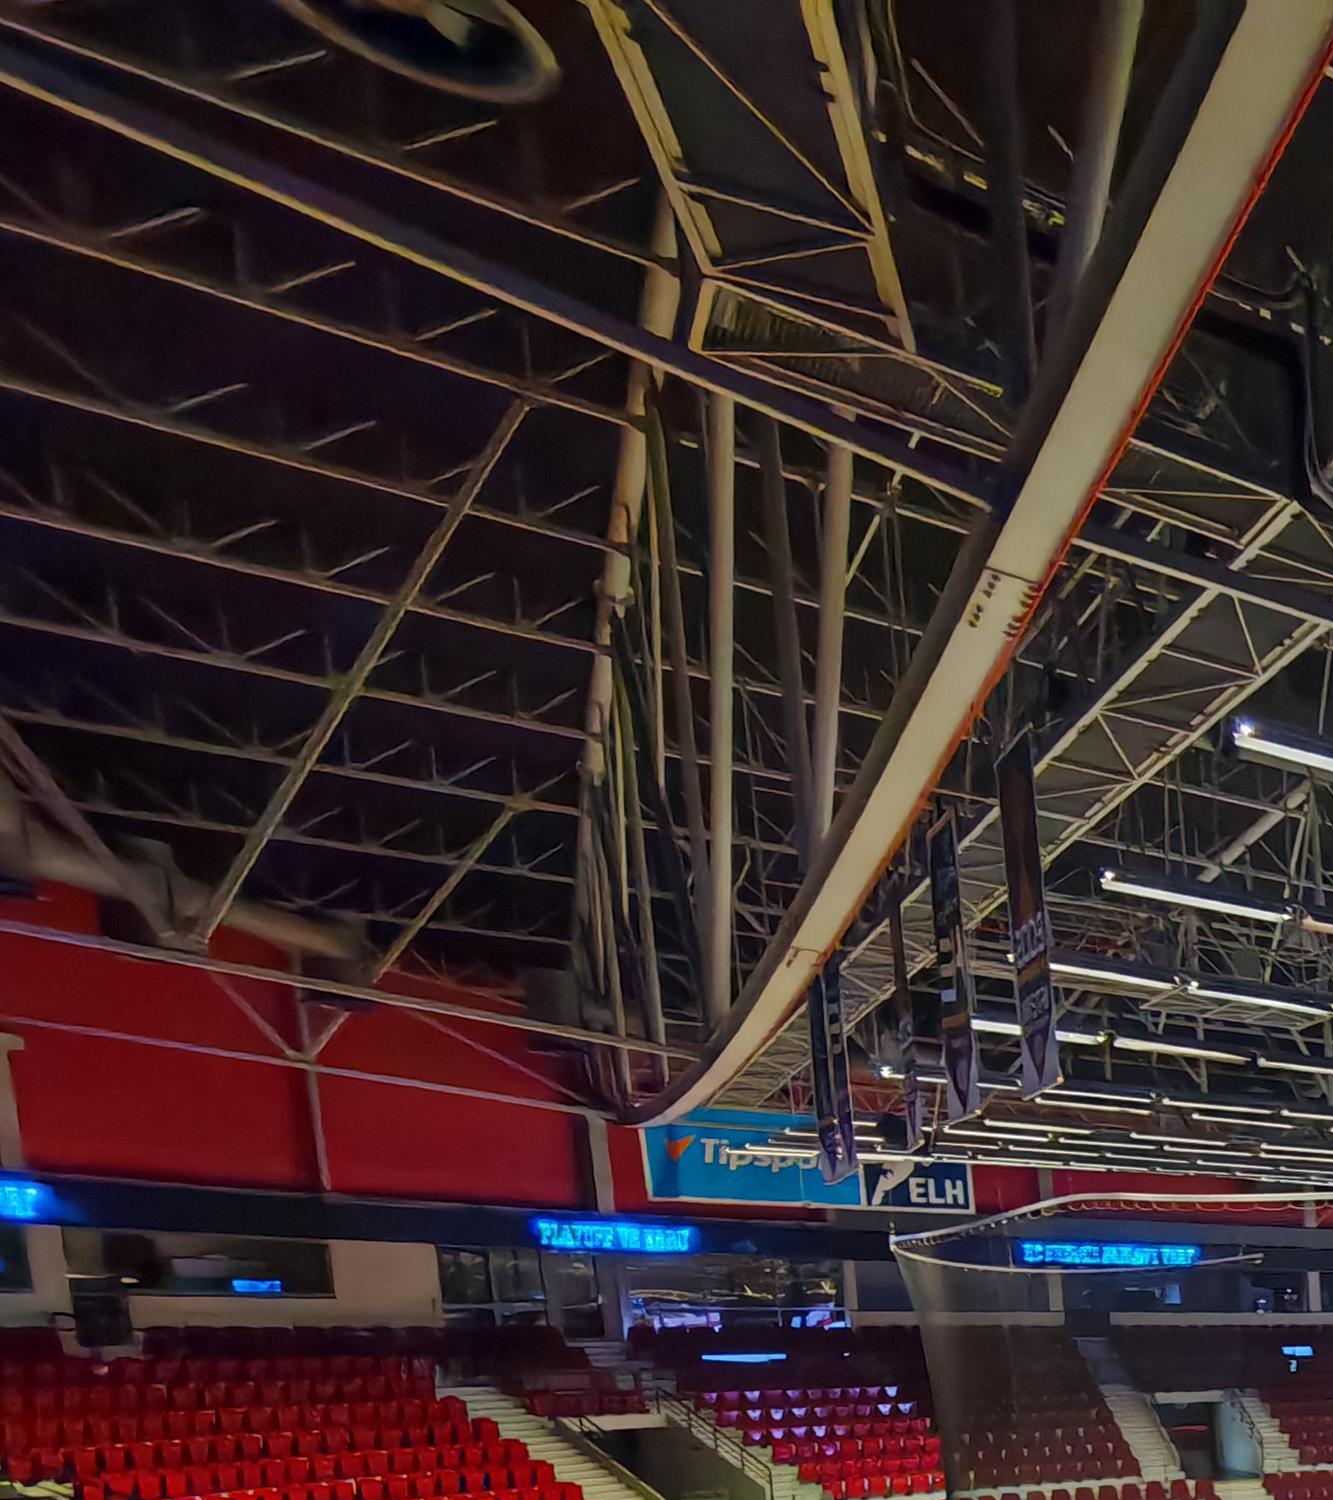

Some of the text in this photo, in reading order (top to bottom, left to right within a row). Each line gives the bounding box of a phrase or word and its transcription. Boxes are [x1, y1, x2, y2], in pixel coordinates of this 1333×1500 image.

[700, 1138, 820, 1172] Tipspo
[908, 1177, 965, 1204] ELH
[539, 1221, 613, 1248] PLAYOFF
